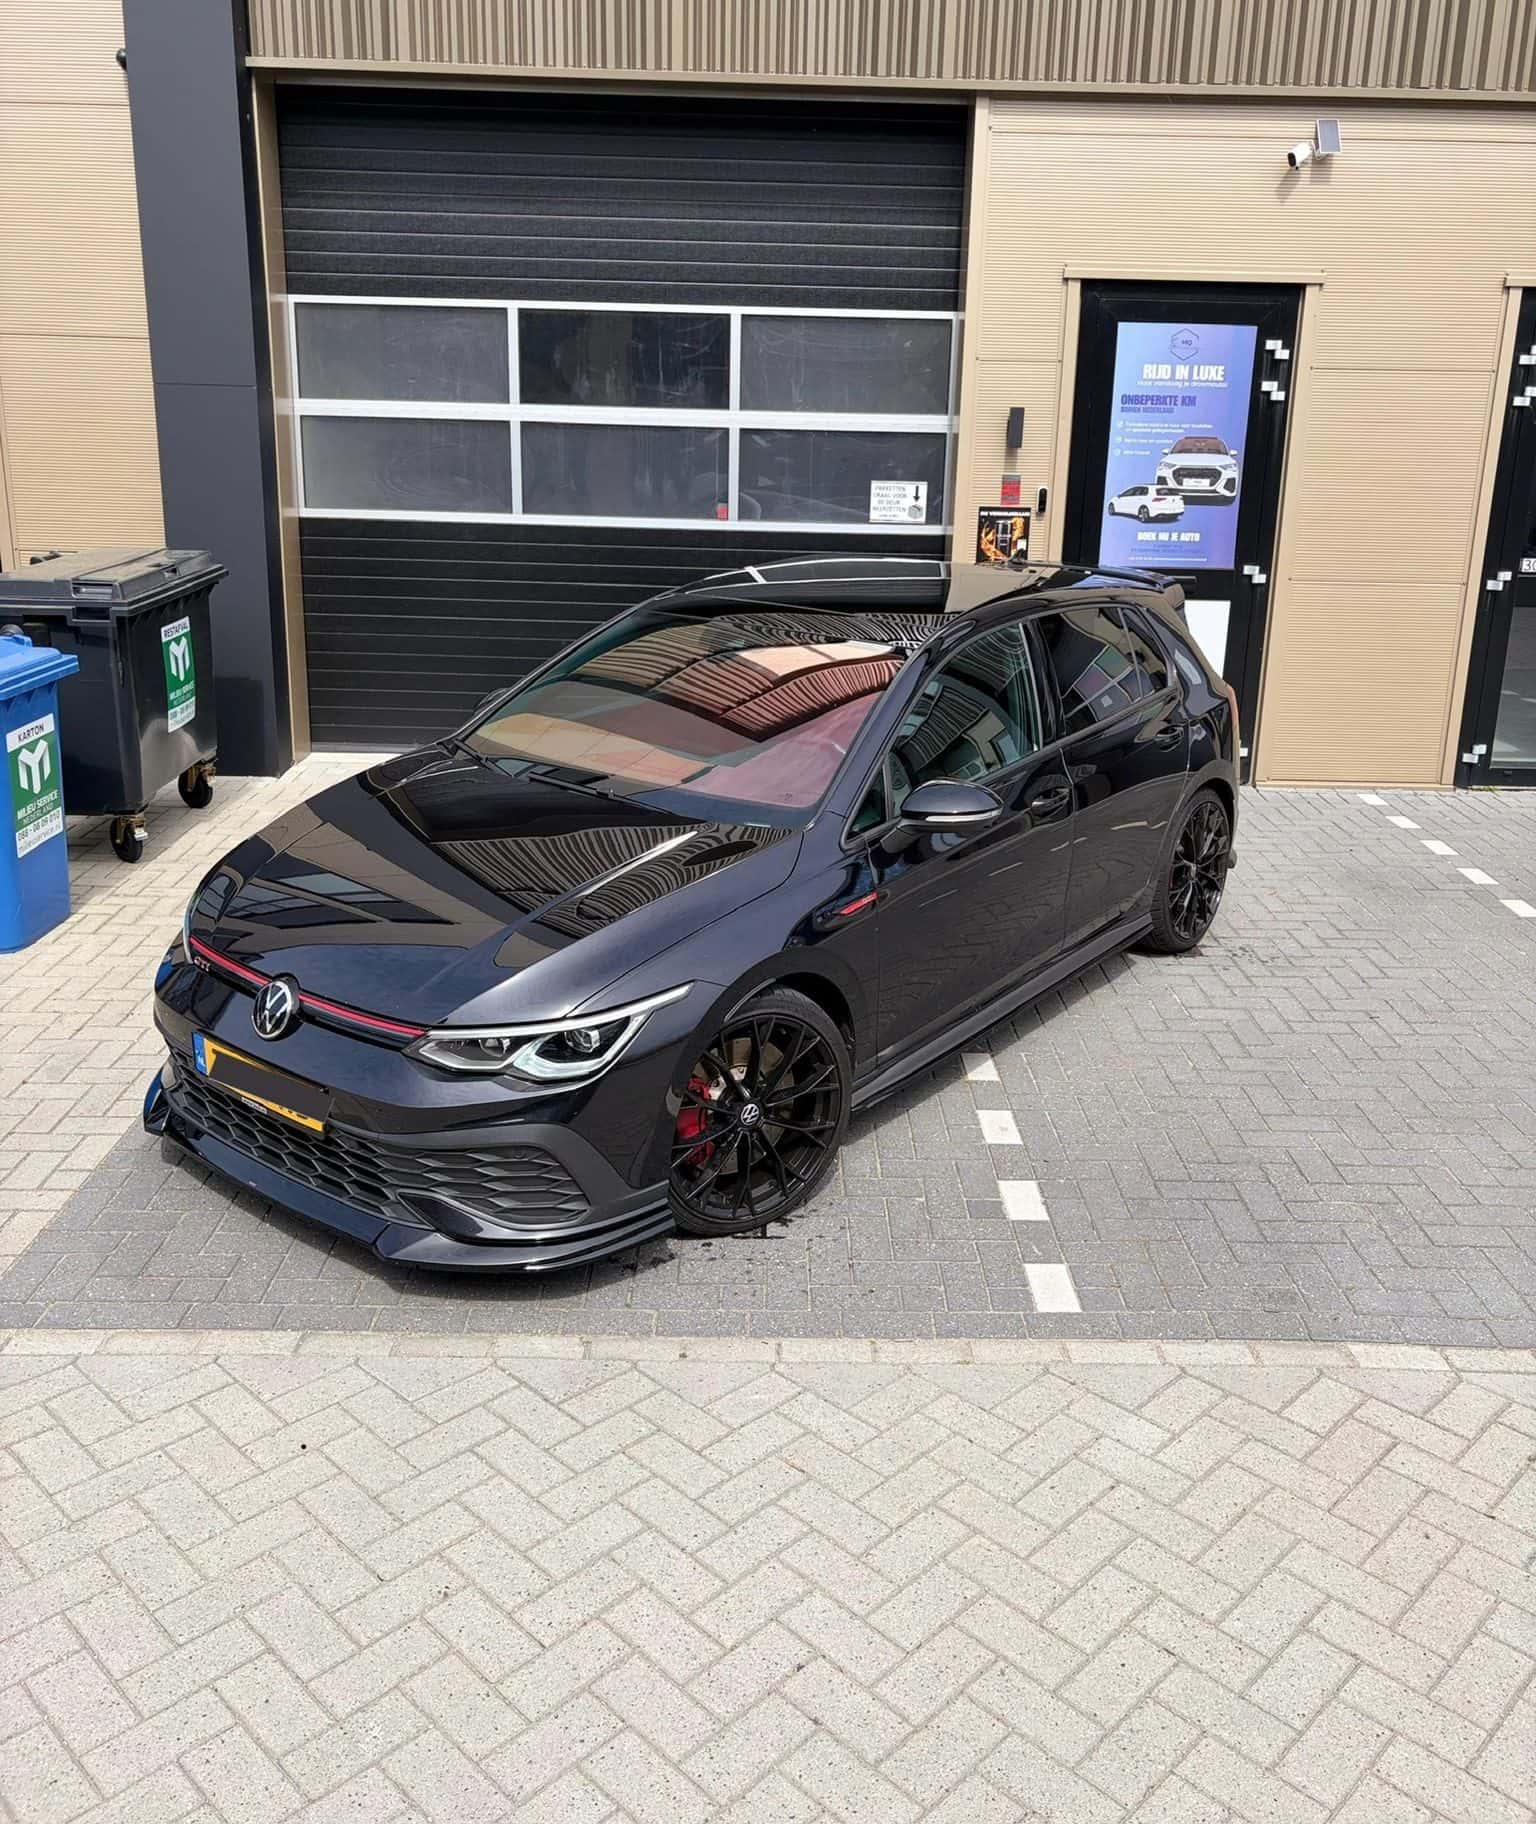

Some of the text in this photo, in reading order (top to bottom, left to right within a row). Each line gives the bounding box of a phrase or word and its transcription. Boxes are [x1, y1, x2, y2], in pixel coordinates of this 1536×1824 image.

[1143, 363, 1225, 381] RIJD IN LUXE
[1121, 394, 1198, 407] ONBEPERKTE KM
[1179, 532, 1201, 542] AUTO
[17, 723, 45, 742] KARTON
